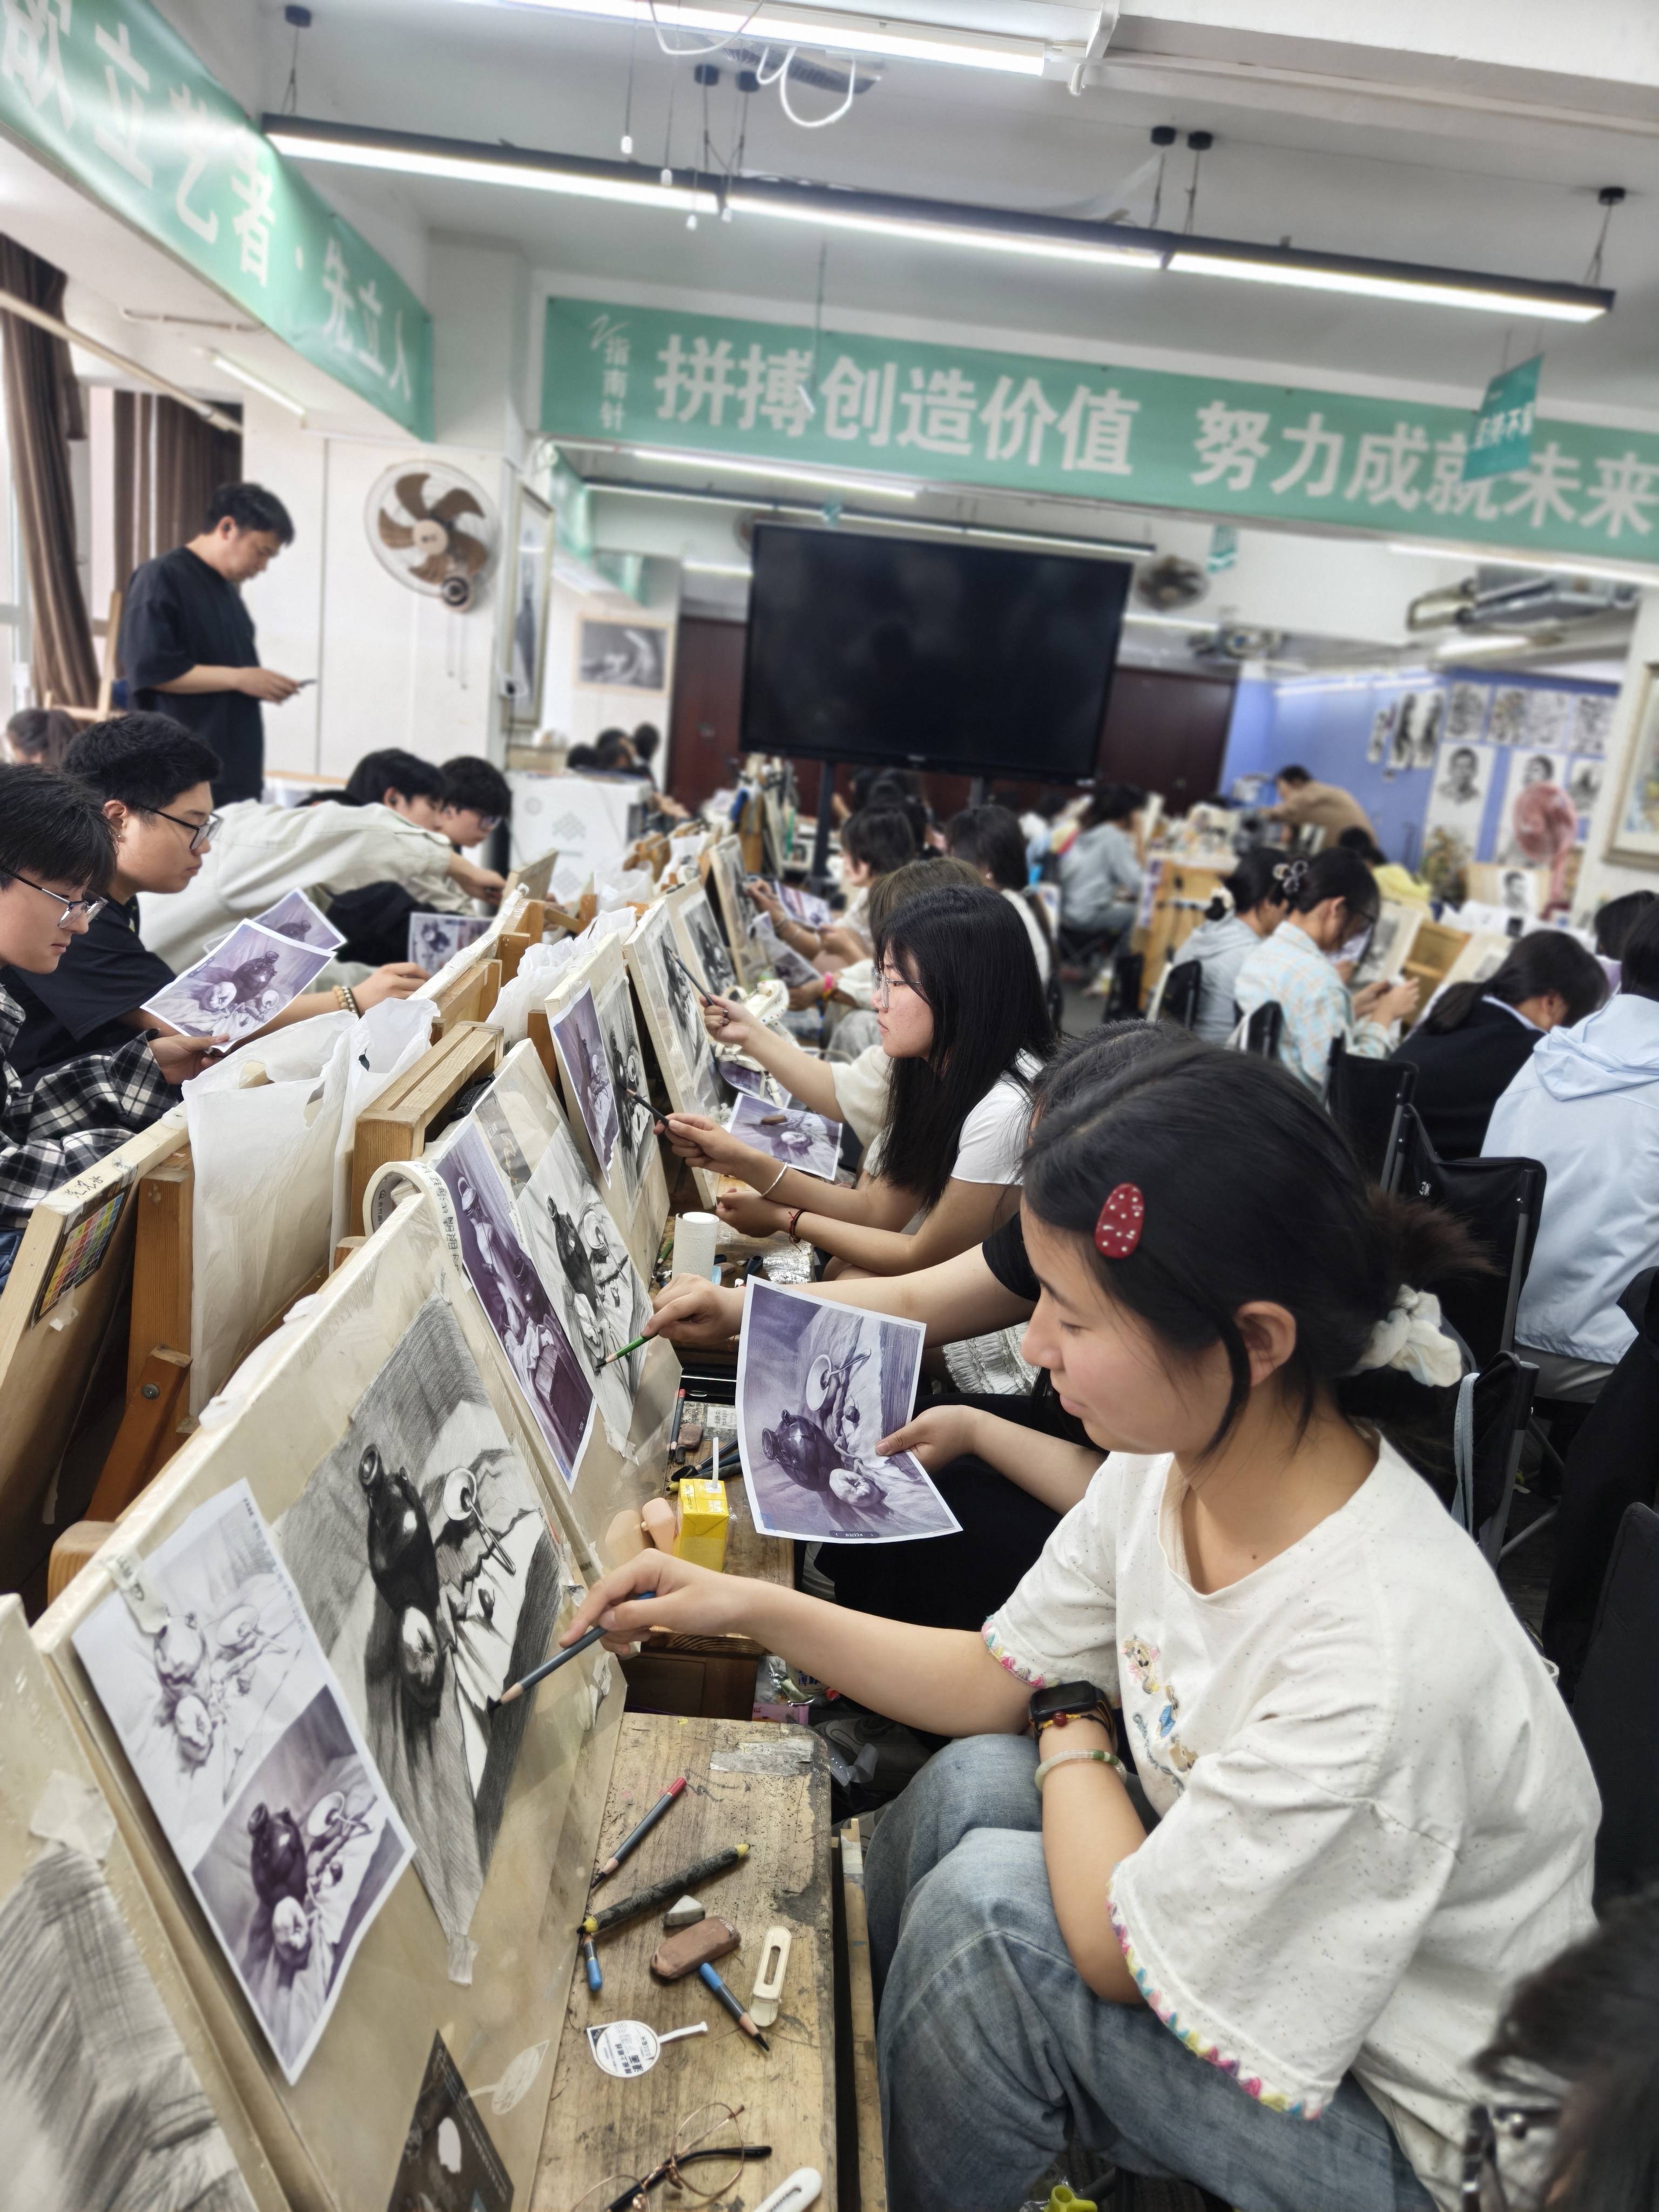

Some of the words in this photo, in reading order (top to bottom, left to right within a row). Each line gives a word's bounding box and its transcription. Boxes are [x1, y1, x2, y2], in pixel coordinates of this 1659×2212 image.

[601, 337, 630, 433] 指南针
[652, 333, 1142, 476] 拼搏创造价值
[1190, 400, 1659, 539] 努力成就未来
